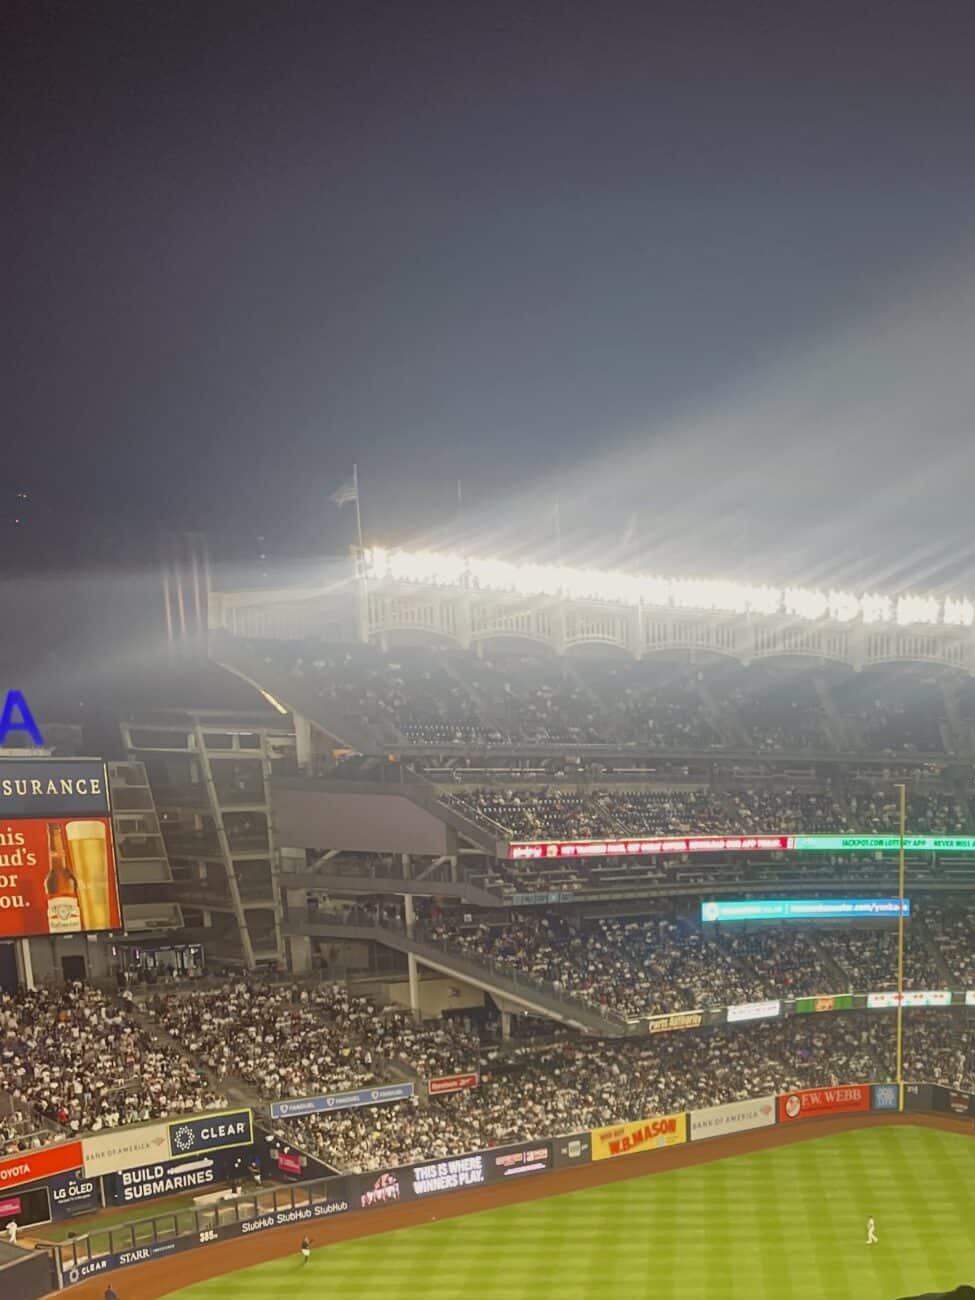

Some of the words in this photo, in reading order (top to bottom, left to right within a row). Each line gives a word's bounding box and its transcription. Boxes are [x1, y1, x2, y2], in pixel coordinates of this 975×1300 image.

[0, 690, 44, 746] A
[2, 779, 101, 796] SURANCE
[824, 1088, 862, 1103] WEBB
[692, 1120, 713, 1130] BANK
[725, 1112, 758, 1124] AMERICA
[201, 1123, 245, 1140] CLEAR
[86, 1151, 106, 1161] BANK
[116, 1143, 150, 1156] AMERICA
[123, 1166, 164, 1186] BUILD
[413, 1165, 437, 1180] THIS
[438, 1163, 447, 1177] IS
[448, 1156, 482, 1174] WHERE
[53, 1189, 66, 1200] LG
[68, 1183, 93, 1196] OLED
[124, 1170, 214, 1200] SUBMARINES
[412, 1173, 458, 1194] WINNERS
[276, 1209, 312, 1224] StubHub
[314, 1201, 348, 1216] StubHub
[242, 1217, 275, 1233] StubHub
[119, 1249, 150, 1265] STARR
[81, 1260, 107, 1275] CLEAR
